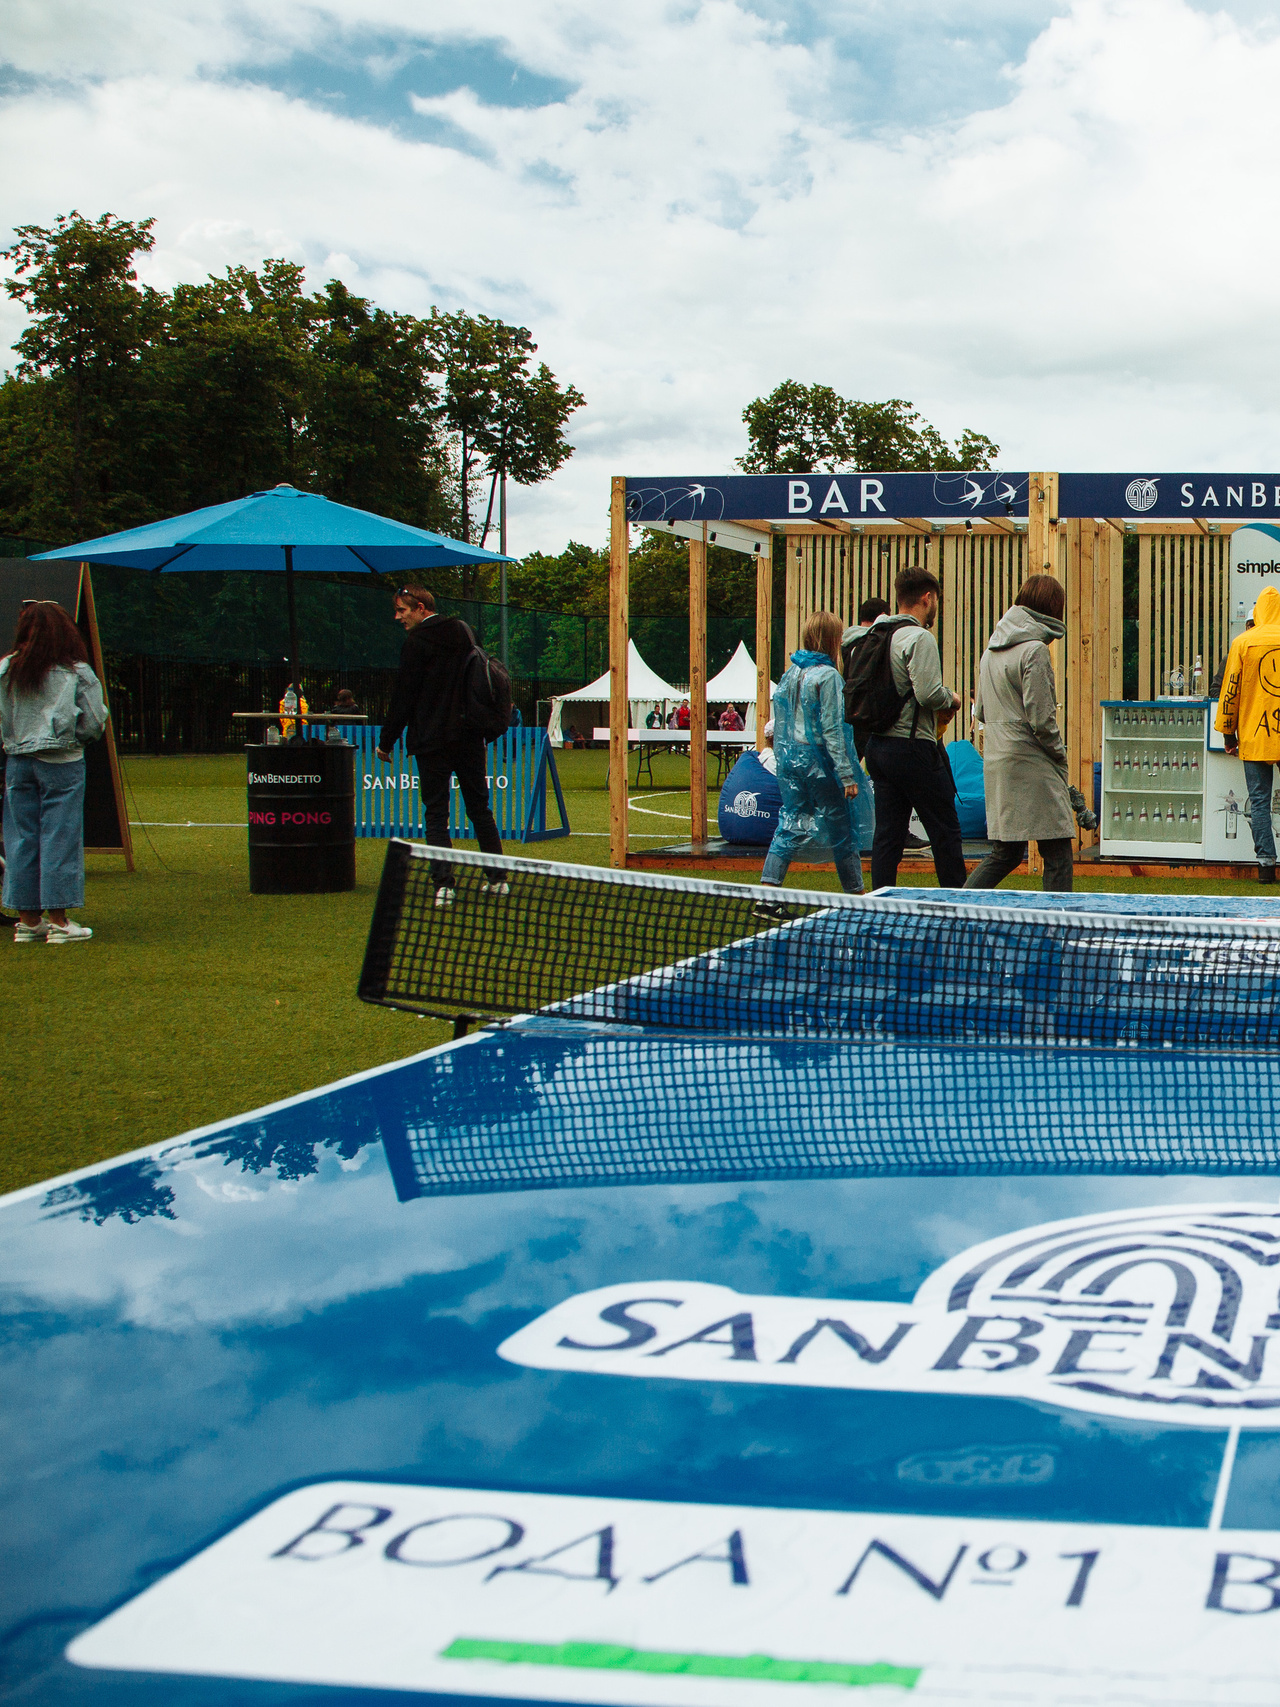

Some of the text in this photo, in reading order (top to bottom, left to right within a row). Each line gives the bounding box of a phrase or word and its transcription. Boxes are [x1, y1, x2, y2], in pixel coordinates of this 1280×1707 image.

[788, 479, 887, 514] BAR
[253, 773, 322, 784] SANBENEDETTO
[363, 773, 509, 790] SANBEDTO
[281, 811, 332, 825] PONG
[272, 1502, 752, 1595] ВОДА
